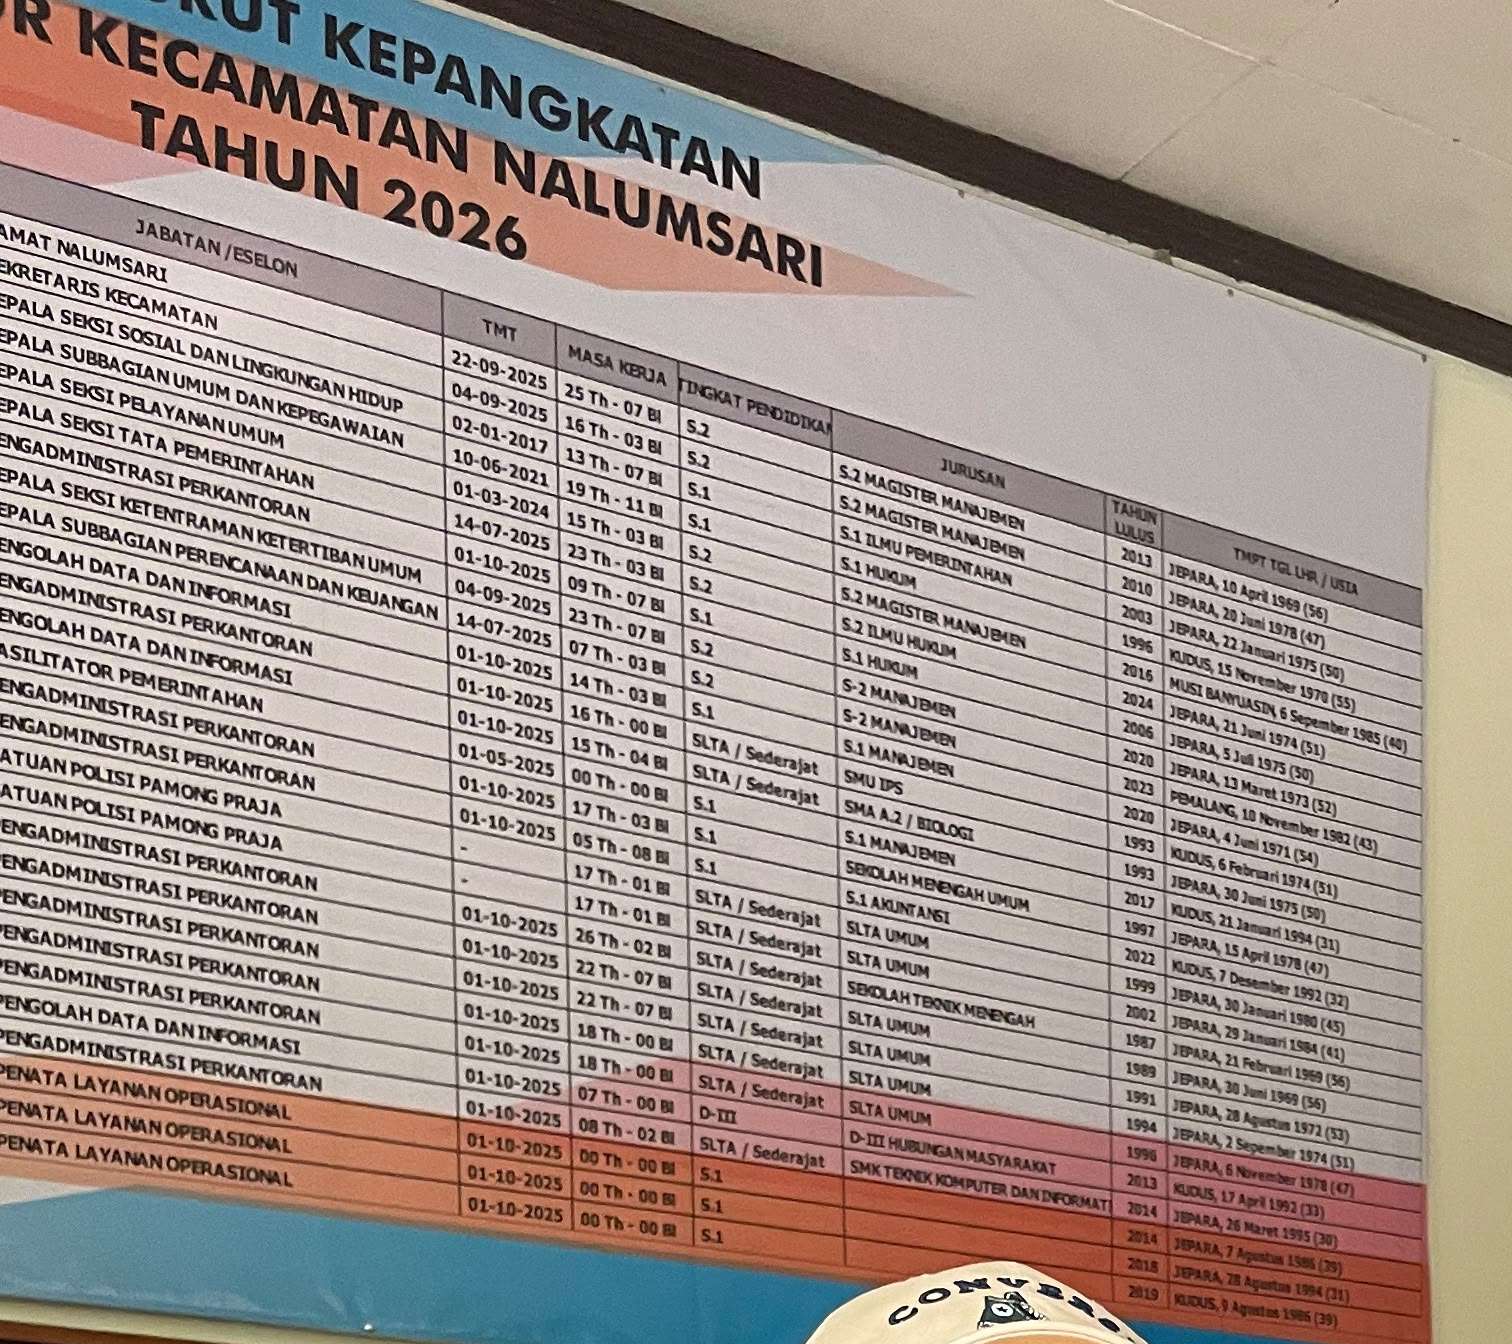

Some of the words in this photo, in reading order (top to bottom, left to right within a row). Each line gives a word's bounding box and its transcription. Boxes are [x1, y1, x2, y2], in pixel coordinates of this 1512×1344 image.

[325, 13, 760, 199] KEPANGKATAN
[79, 8, 468, 173] KECAMATAN
[494, 139, 822, 288] NALUMSARI
[131, 100, 358, 211] TAHUN
[383, 178, 528, 262] 2026
[136, 216, 220, 258] JABATAN
[57, 236, 167, 286] NALUMSARI
[105, 284, 218, 332] KECAMATAN
[482, 318, 517, 343] TMT
[60, 306, 114, 338] SEKSI
[119, 322, 185, 357] SOSIAL
[190, 342, 229, 369] DAN
[233, 353, 346, 401] LINGKUNGAN
[348, 385, 403, 415] HIDUP
[451, 349, 547, 391] 22-09-2025
[568, 344, 613, 371] MASA
[619, 358, 666, 388] KERJA
[60, 341, 169, 388] SUBBAGIAN
[173, 371, 229, 402] UMUM
[235, 388, 275, 414] DAN
[278, 399, 404, 449] KEPEGAWAIAN
[60, 376, 114, 406] SEKSI
[119, 391, 226, 435] PELAYANAN
[228, 420, 284, 450] UMUM
[451, 382, 547, 423] 04-09-2025
[564, 382, 584, 402] 25
[589, 389, 608, 409] Th
[624, 399, 642, 419] 07
[452, 414, 548, 456] 02-01-2017
[686, 418, 710, 438] S.2
[61, 411, 115, 441] SEKSI
[120, 426, 167, 454] TATA
[174, 440, 314, 492] PEMERINTAHAN
[453, 447, 548, 488] 10-06-2021
[687, 481, 710, 501] S.1
[941, 457, 1005, 489] JURUSAN
[179, 474, 310, 524] PERKANTORAN
[453, 480, 549, 520] 01-03-2024
[839, 464, 861, 484] S.2
[864, 472, 937, 507] MAGISTER
[942, 495, 1025, 532] MANAJEMEN
[61, 480, 115, 510] SEKSI
[121, 495, 254, 544] KETENTRAMAN
[258, 528, 365, 571] KETERTIBAN
[368, 555, 422, 584] UMUM
[454, 512, 550, 552] 14-07-2025
[61, 516, 172, 558] SUBBAGIAN
[175, 542, 303, 590] PERENCANAAN
[306, 574, 344, 598] DAN
[347, 583, 439, 621] KEUANGAN
[454, 546, 550, 585] 01-10-2025
[1121, 546, 1152, 569] 2013
[89, 557, 140, 585] DATA
[146, 570, 185, 596] DAN
[188, 579, 291, 620] INFORMASI
[455, 579, 551, 617] 04-09-2025
[1121, 575, 1152, 597] 2010
[456, 612, 552, 649] 14-07-2025
[1121, 604, 1152, 626] 2003
[456, 644, 552, 681] 01-10-2025
[1122, 632, 1153, 655] 1996
[1122, 690, 1153, 711] 2024
[458, 743, 554, 778] 01-05-2025
[691, 732, 730, 756] SLTA
[746, 744, 819, 779] Sederajat
[70, 760, 135, 790] POLISI
[140, 775, 218, 806] PAMONG
[224, 791, 282, 819] PRAJA
[1124, 919, 1155, 939] 1997
[1124, 948, 1155, 967] 2022
[464, 1035, 561, 1066] 01-10-2025
[190, 1057, 322, 1093] PERKANTORAN
[74, 1074, 162, 1103] LAYANAN
[164, 1087, 291, 1121] OPERASIONAL
[1125, 1089, 1156, 1107] 1991
[466, 1132, 562, 1161] 01-10-2025
[468, 1196, 563, 1223] 01-10-2025
